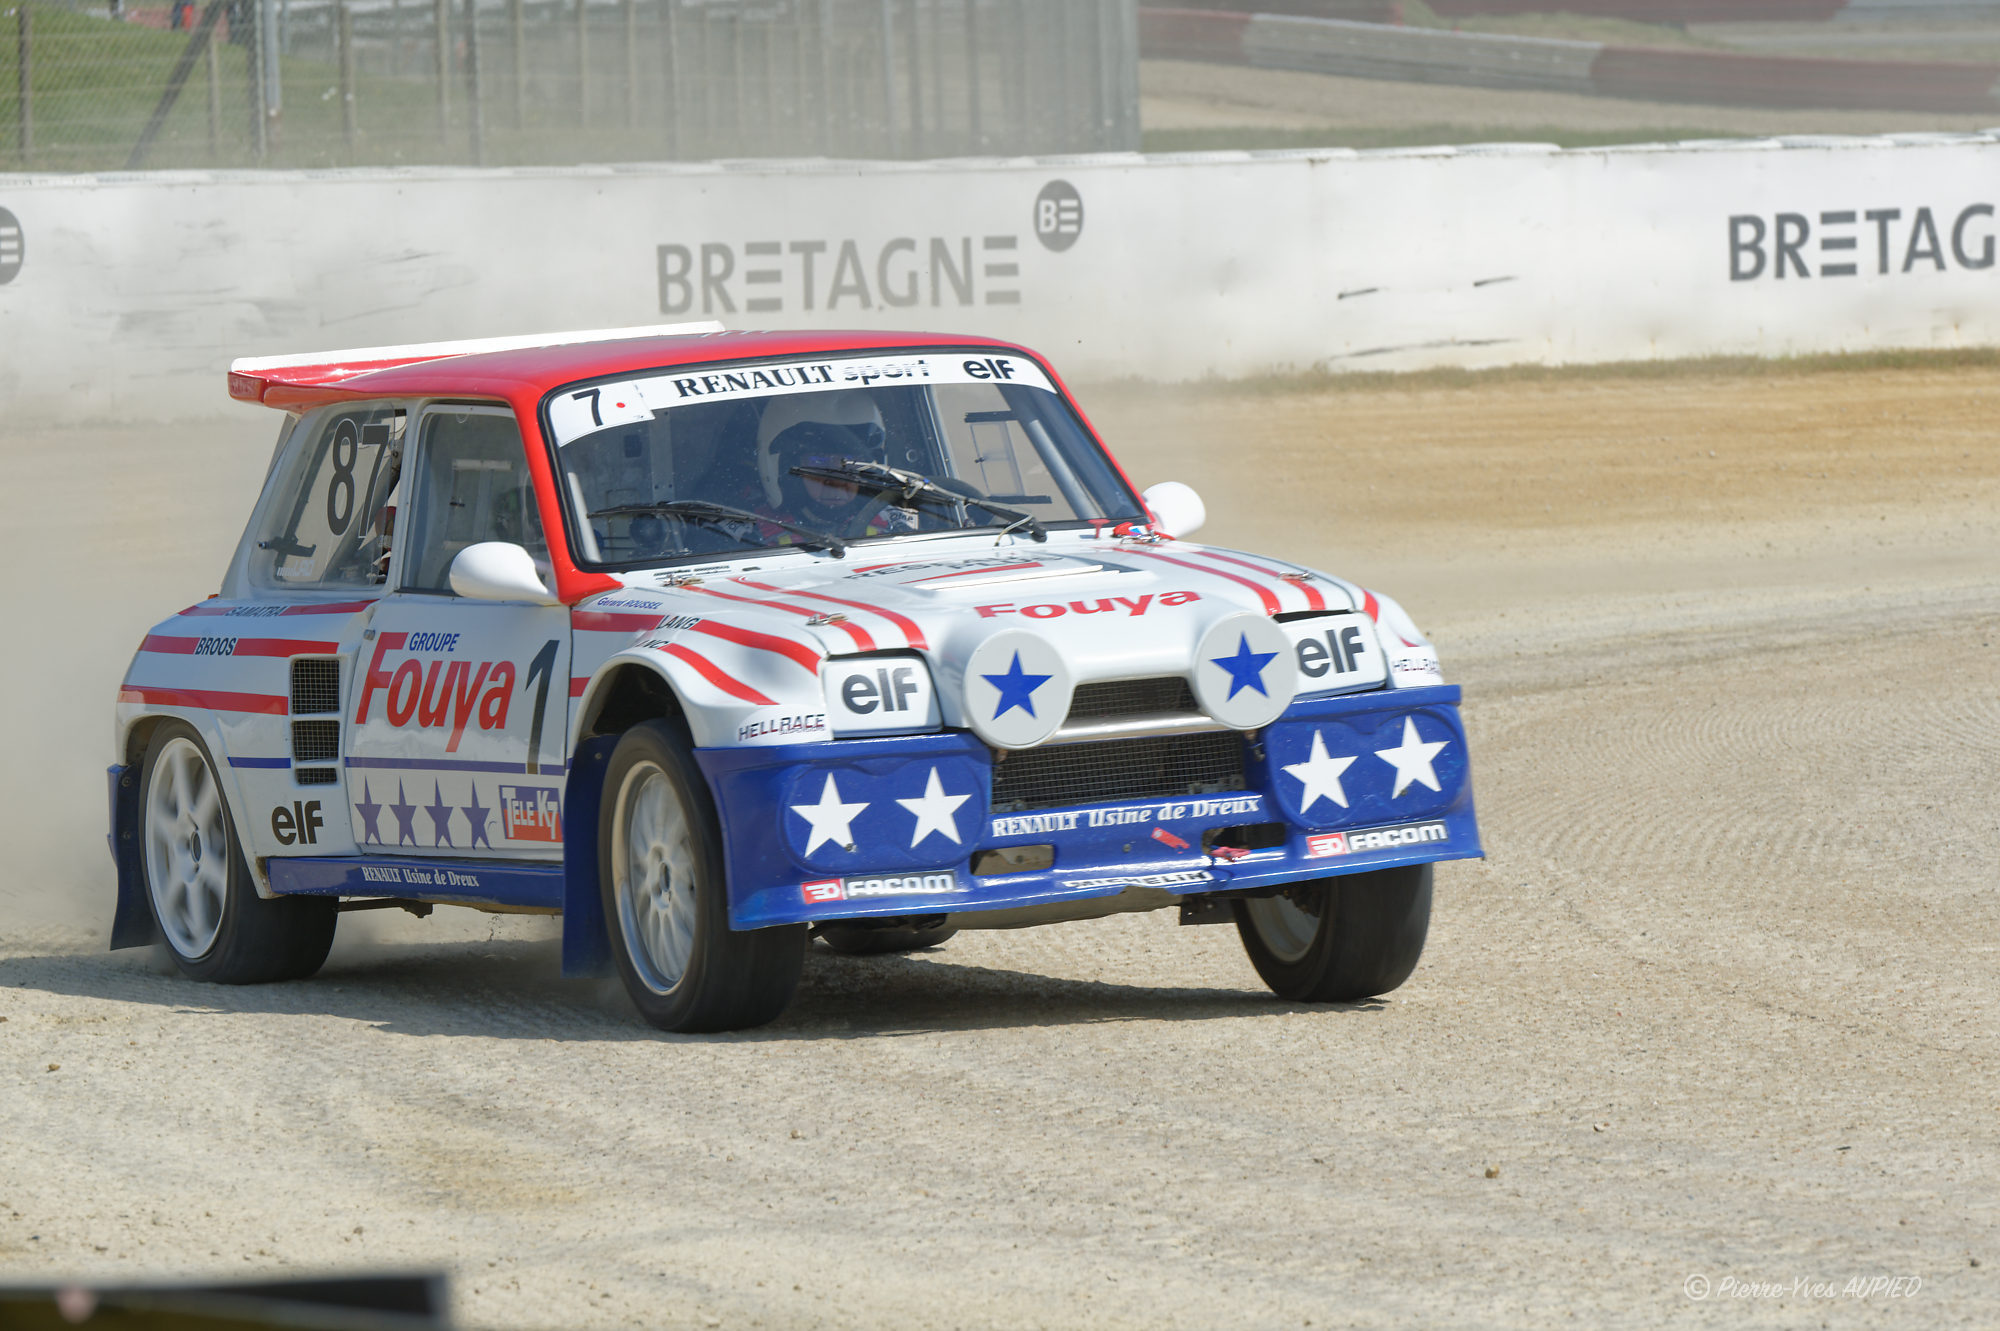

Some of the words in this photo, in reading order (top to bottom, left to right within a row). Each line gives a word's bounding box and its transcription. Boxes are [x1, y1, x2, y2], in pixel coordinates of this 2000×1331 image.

[1038, 198, 1080, 234] BE
[1728, 203, 1996, 282] BRETAG
[657, 235, 1022, 316] BRETAGNE
[672, 364, 834, 399] RENAULT
[843, 358, 930, 385] sport
[963, 358, 1015, 380] elf
[571, 387, 604, 427] 7
[327, 418, 390, 540] 87
[655, 614, 701, 630] LANG
[973, 590, 1202, 619] Fouya
[194, 637, 237, 656] BROOS
[409, 632, 460, 652] GROUPE
[1296, 626, 1365, 678] elf
[355, 631, 516, 753] Fouya
[841, 667, 918, 714] elf
[738, 713, 826, 742] HELLRACE
[271, 800, 324, 846] elf
[992, 814, 1080, 838] RENAULT
[1088, 808, 1152, 828] Usine
[1156, 803, 1187, 821] de
[1191, 798, 1260, 818] Dreux
[361, 866, 401, 883] RENAULT
[402, 868, 433, 885] Usine
[433, 868, 448, 886] de
[447, 871, 480, 888] Dreux
